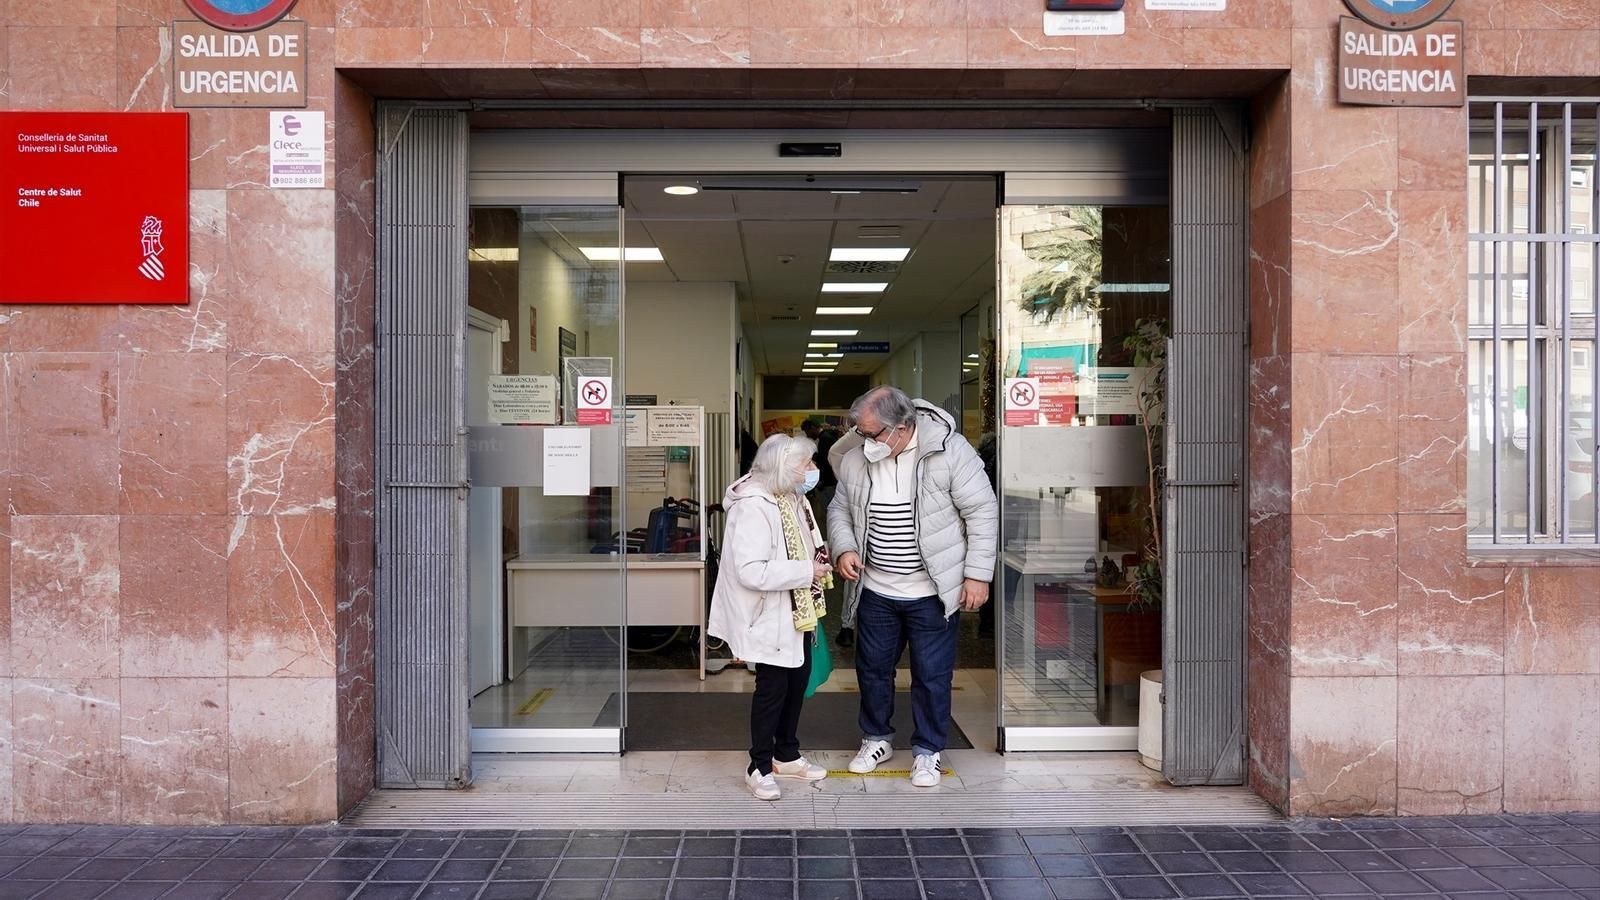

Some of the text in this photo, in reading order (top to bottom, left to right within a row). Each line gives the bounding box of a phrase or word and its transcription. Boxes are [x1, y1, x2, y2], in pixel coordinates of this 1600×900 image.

[180, 35, 299, 57] SALIDA DE
[1344, 32, 1456, 56] SALIDA DE
[180, 71, 299, 93] URGENCIA
[1344, 68, 1456, 92] URGENCIA
[18, 133, 108, 142] Conselleria de Sanitat
[18, 144, 57, 153] Universal
[63, 144, 85, 153] Salut
[87, 144, 118, 153] Pública
[273, 140, 302, 150] Clece
[18, 188, 82, 196] Centre de Salut
[18, 199, 40, 207] Chile
